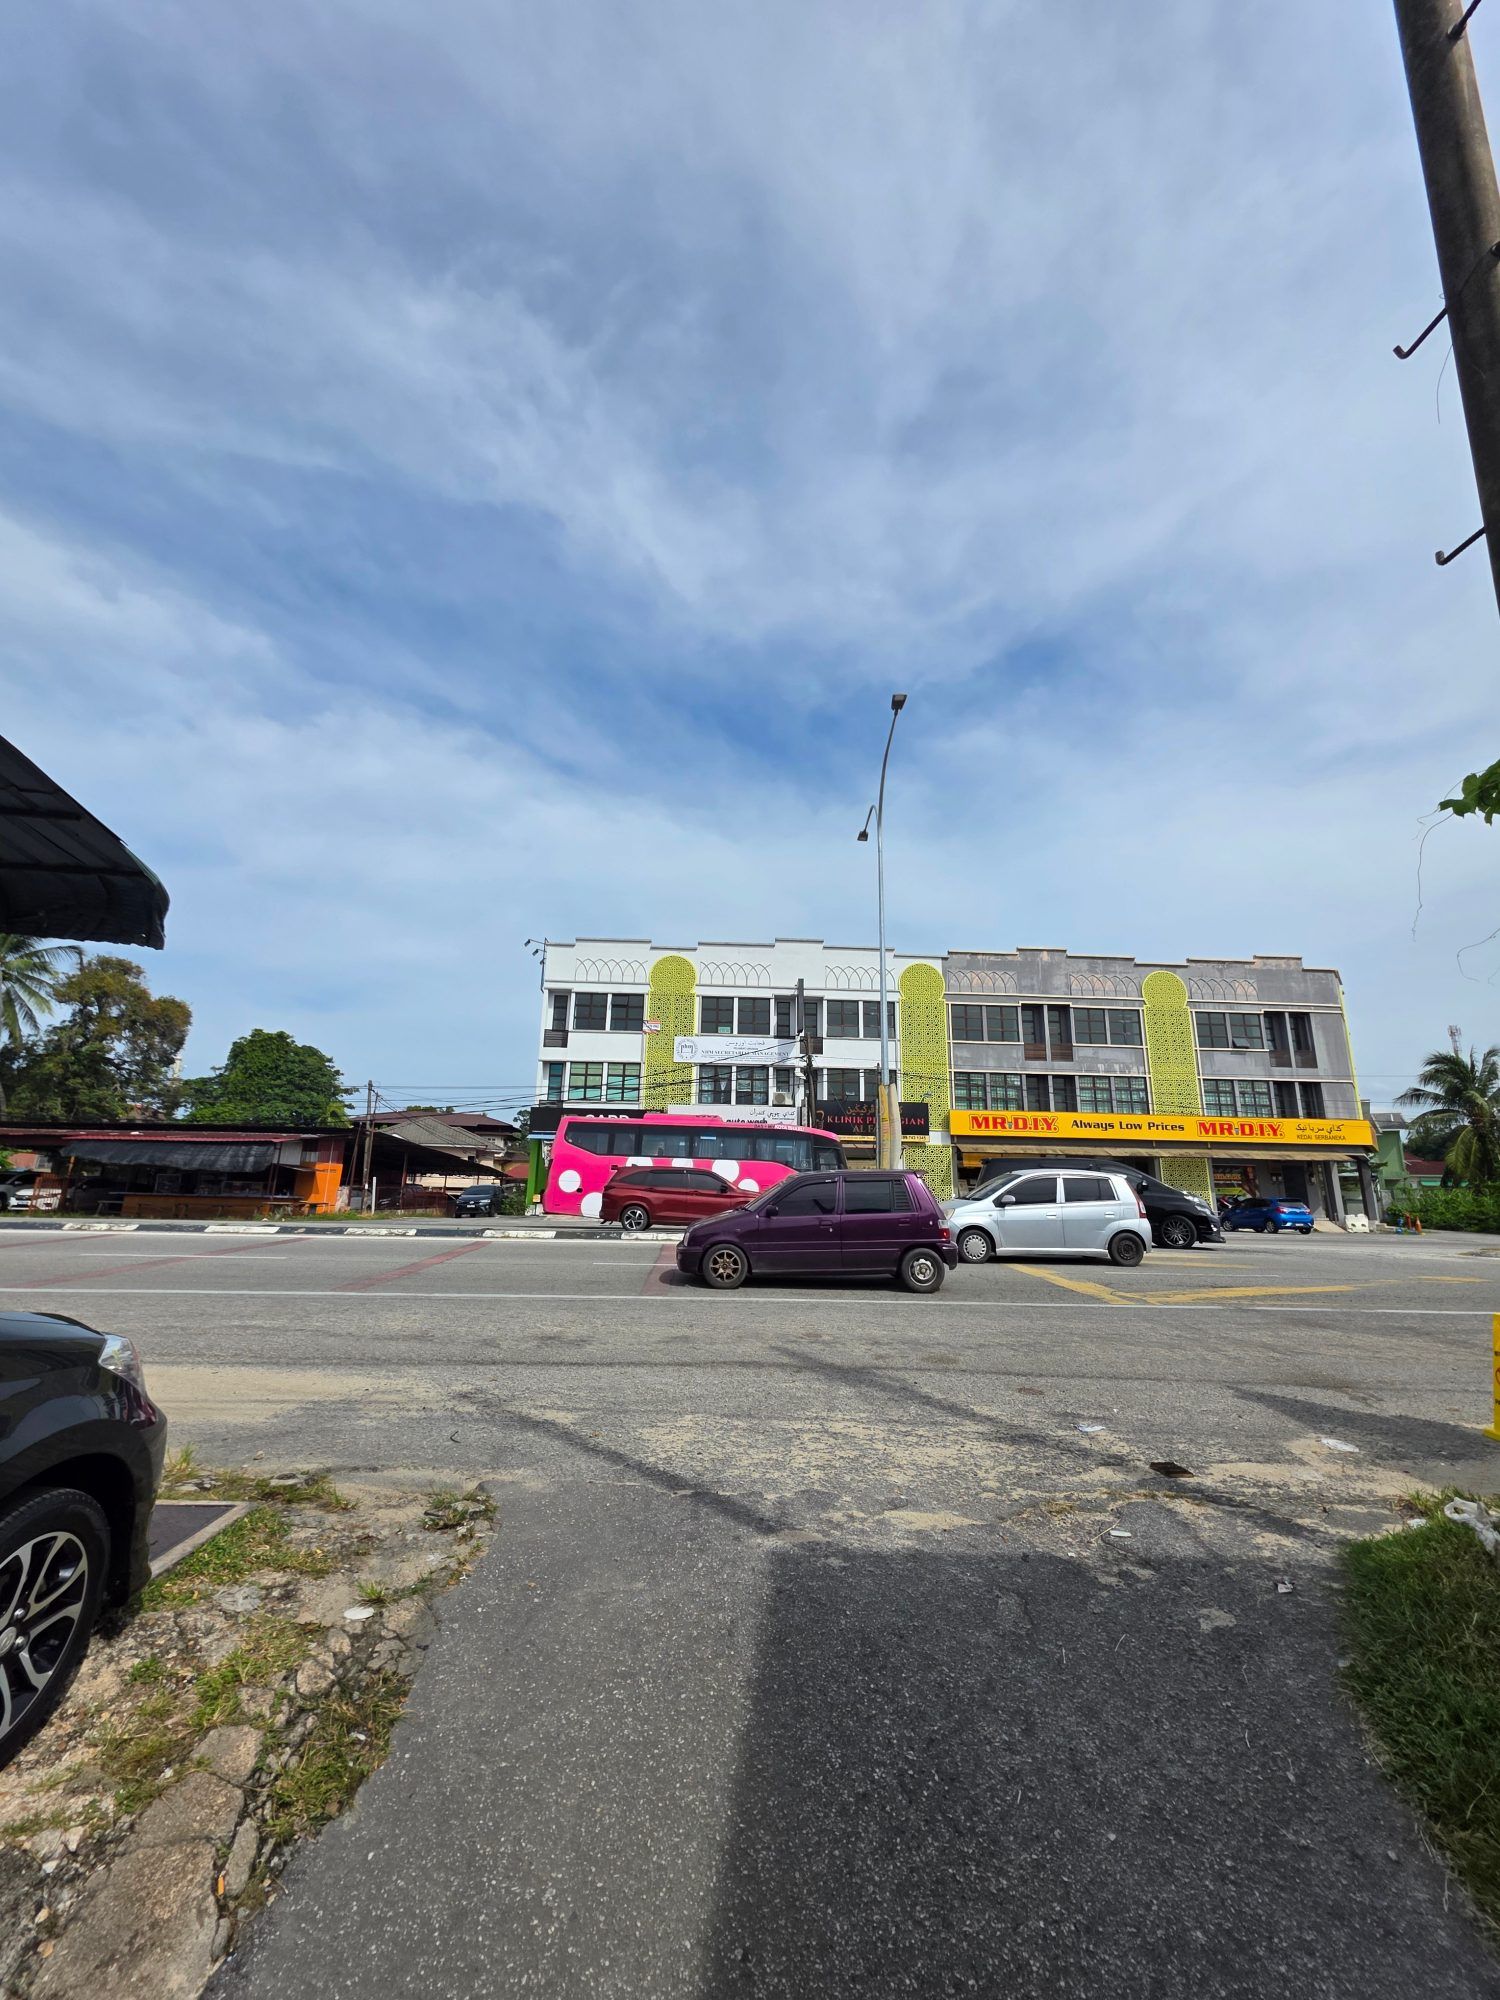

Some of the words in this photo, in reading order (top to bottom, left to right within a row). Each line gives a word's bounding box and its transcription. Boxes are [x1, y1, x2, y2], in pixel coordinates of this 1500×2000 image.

[827, 1115, 864, 1124] KLINIK
[1071, 1119, 1115, 1132] Always
[1119, 1121, 1143, 1130] Low
[1148, 1122, 1185, 1132] Prices
